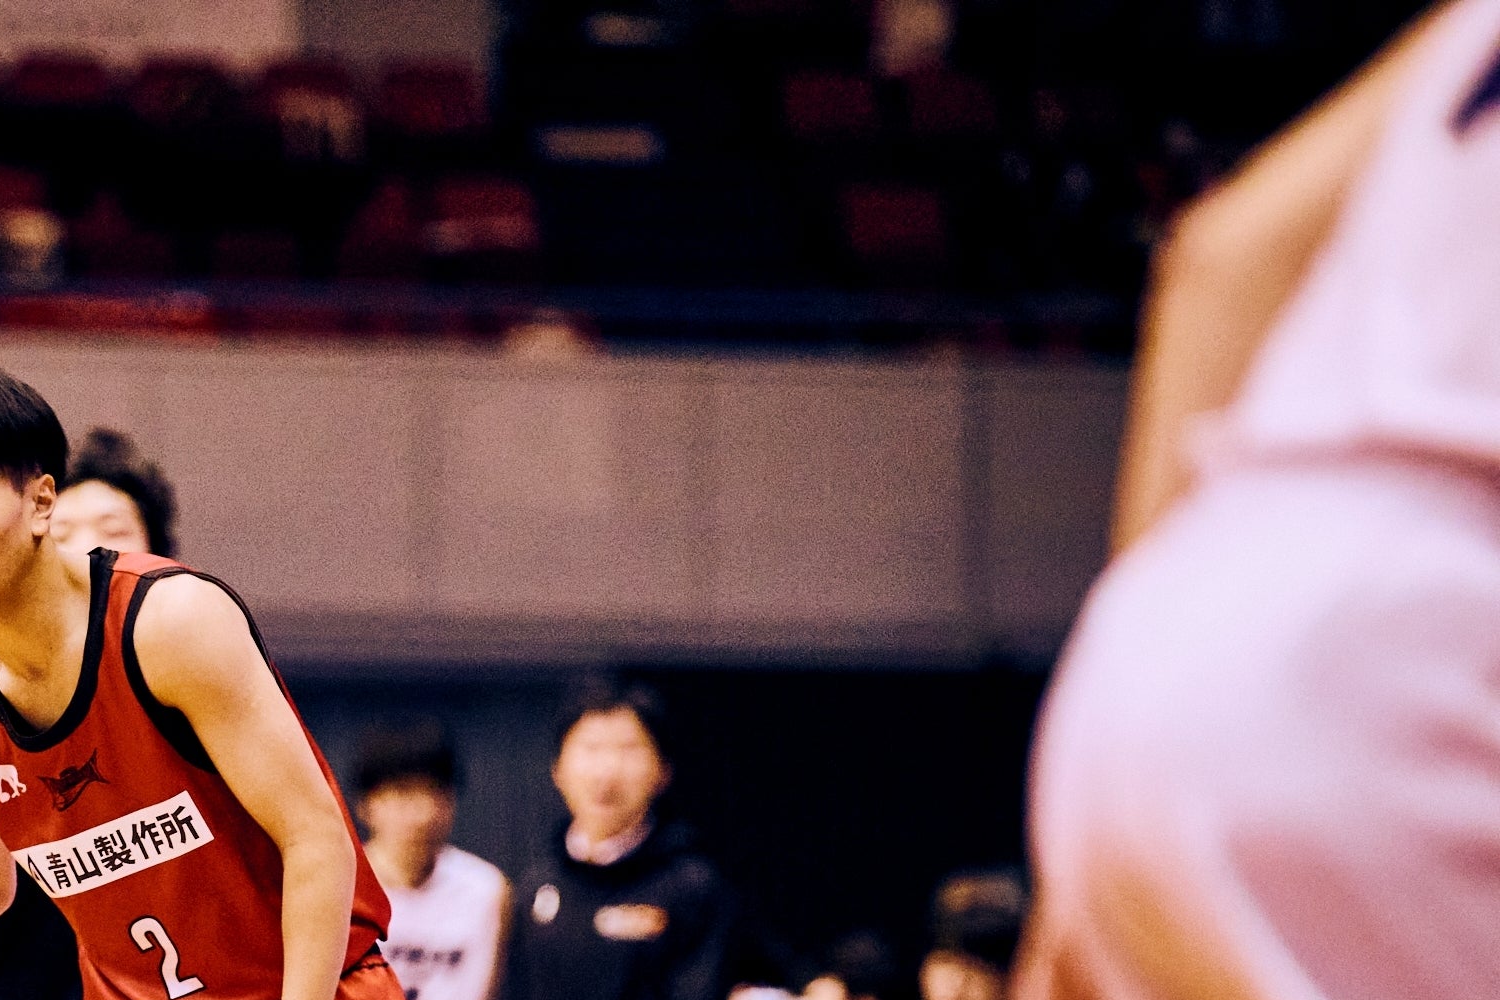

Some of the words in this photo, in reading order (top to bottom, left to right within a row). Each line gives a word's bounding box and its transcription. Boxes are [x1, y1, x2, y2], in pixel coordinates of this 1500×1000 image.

[46, 805, 200, 890] 青山製作所
[128, 915, 206, 1000] 2
